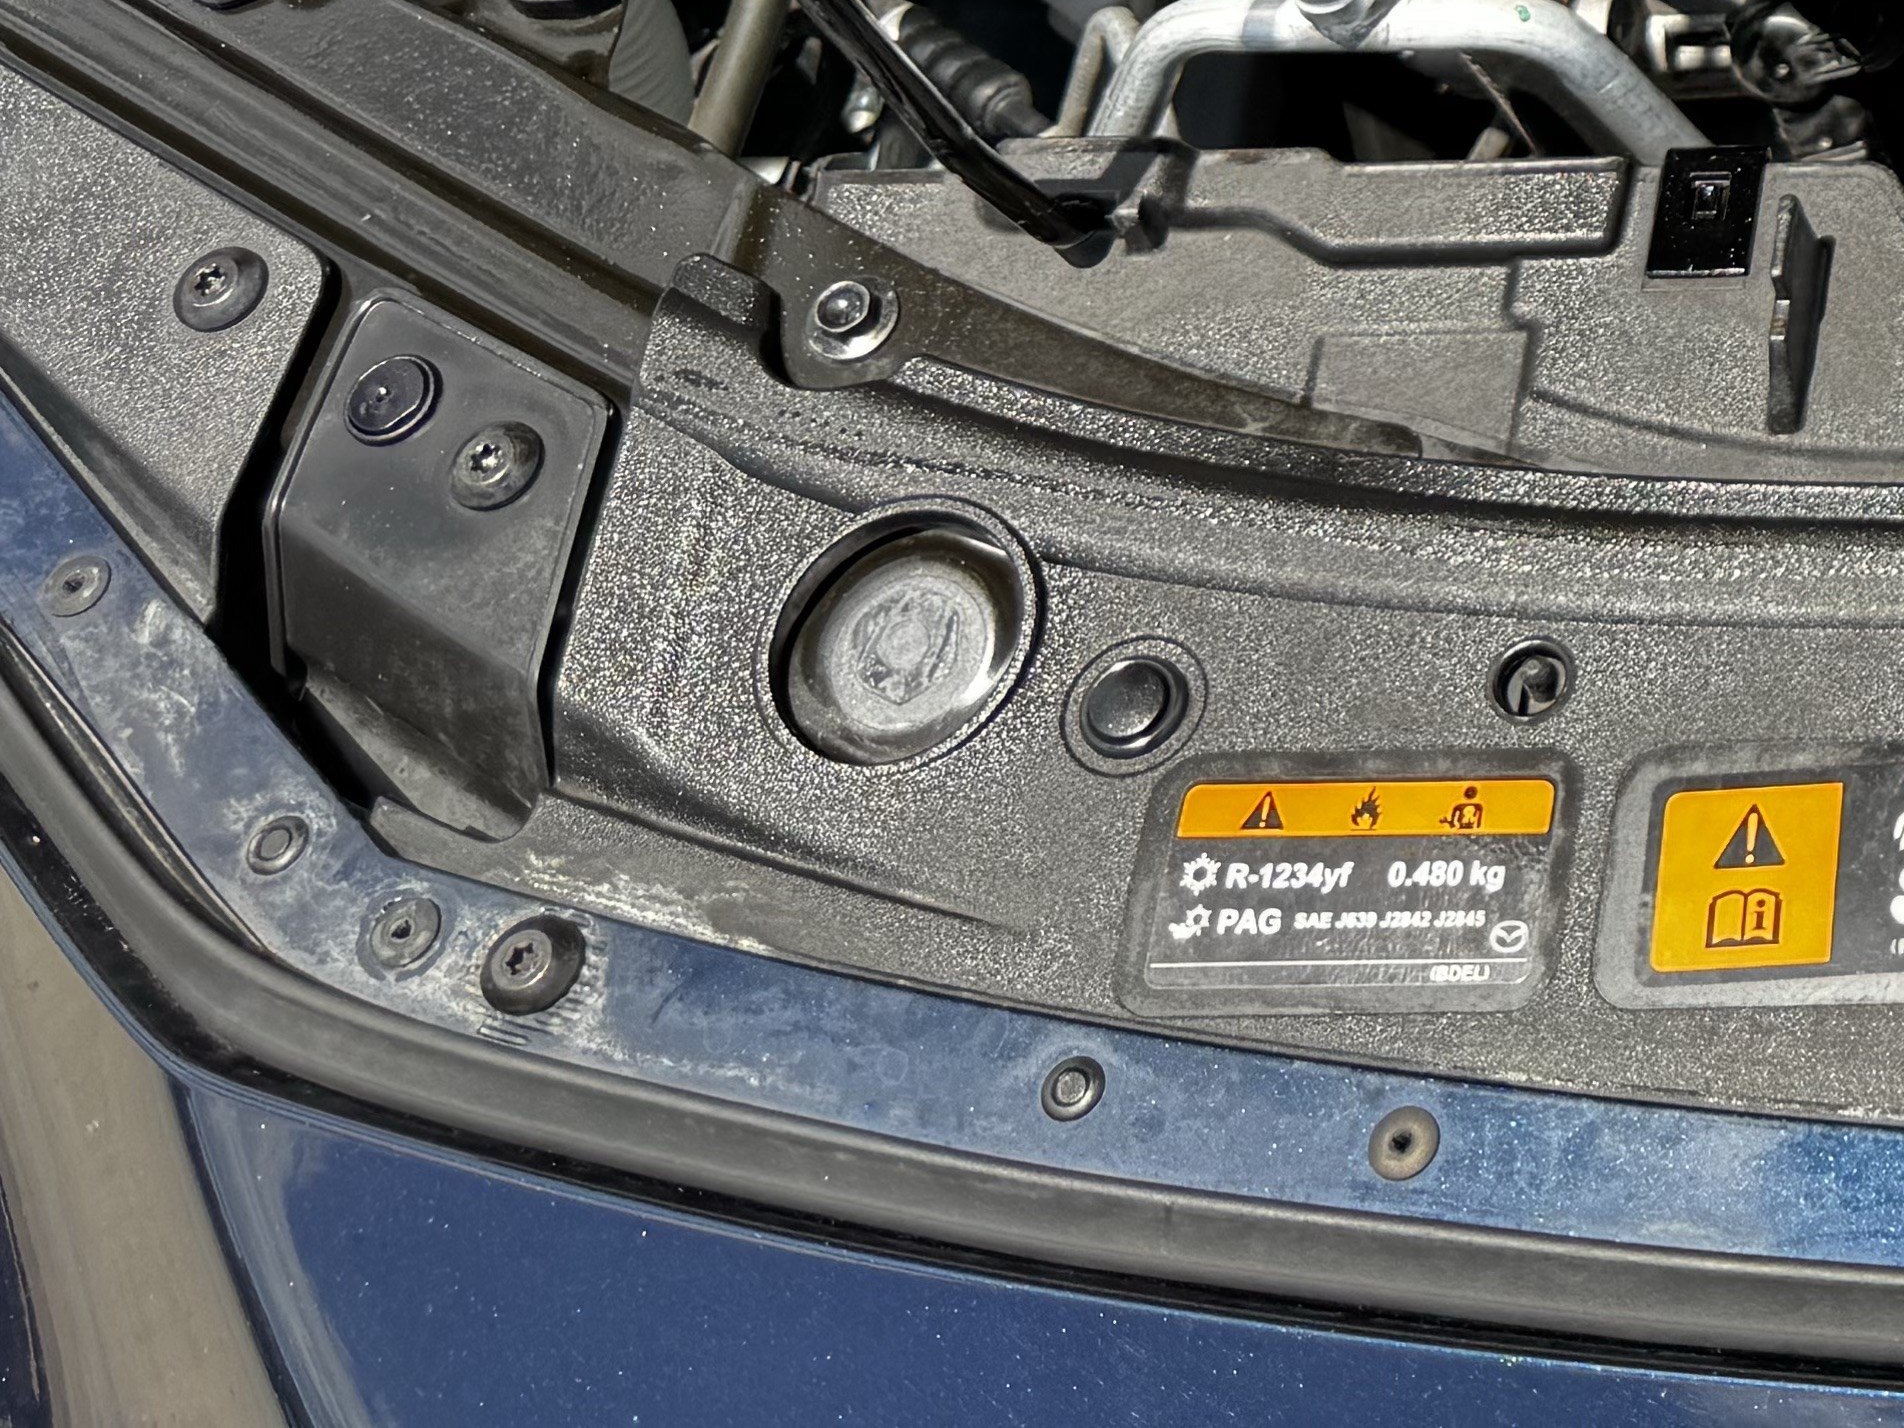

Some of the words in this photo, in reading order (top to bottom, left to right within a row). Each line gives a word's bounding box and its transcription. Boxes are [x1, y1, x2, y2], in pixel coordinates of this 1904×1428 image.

[1225, 861, 1355, 894] R-1234yf
[1387, 860, 1464, 887] 0.480
[1469, 860, 1506, 892] kg
[1216, 907, 1282, 935] PAG
[1294, 912, 1333, 929] SAE
